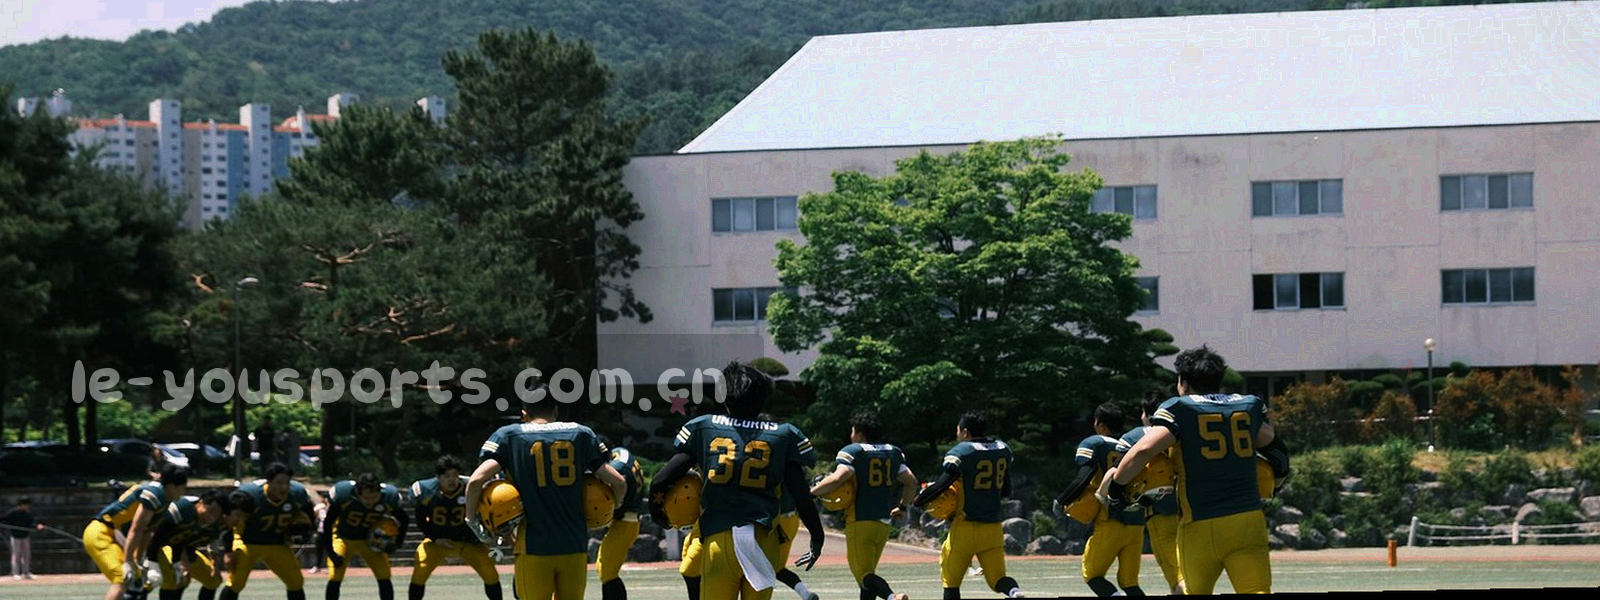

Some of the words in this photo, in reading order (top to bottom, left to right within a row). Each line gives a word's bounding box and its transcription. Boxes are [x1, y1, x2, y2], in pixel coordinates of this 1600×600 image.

[1197, 411, 1254, 459] 56
[530, 440, 576, 487] 18
[708, 437, 771, 488] 32
[869, 457, 892, 487] 61
[973, 458, 1007, 489] 28
[432, 506, 465, 526] 63
